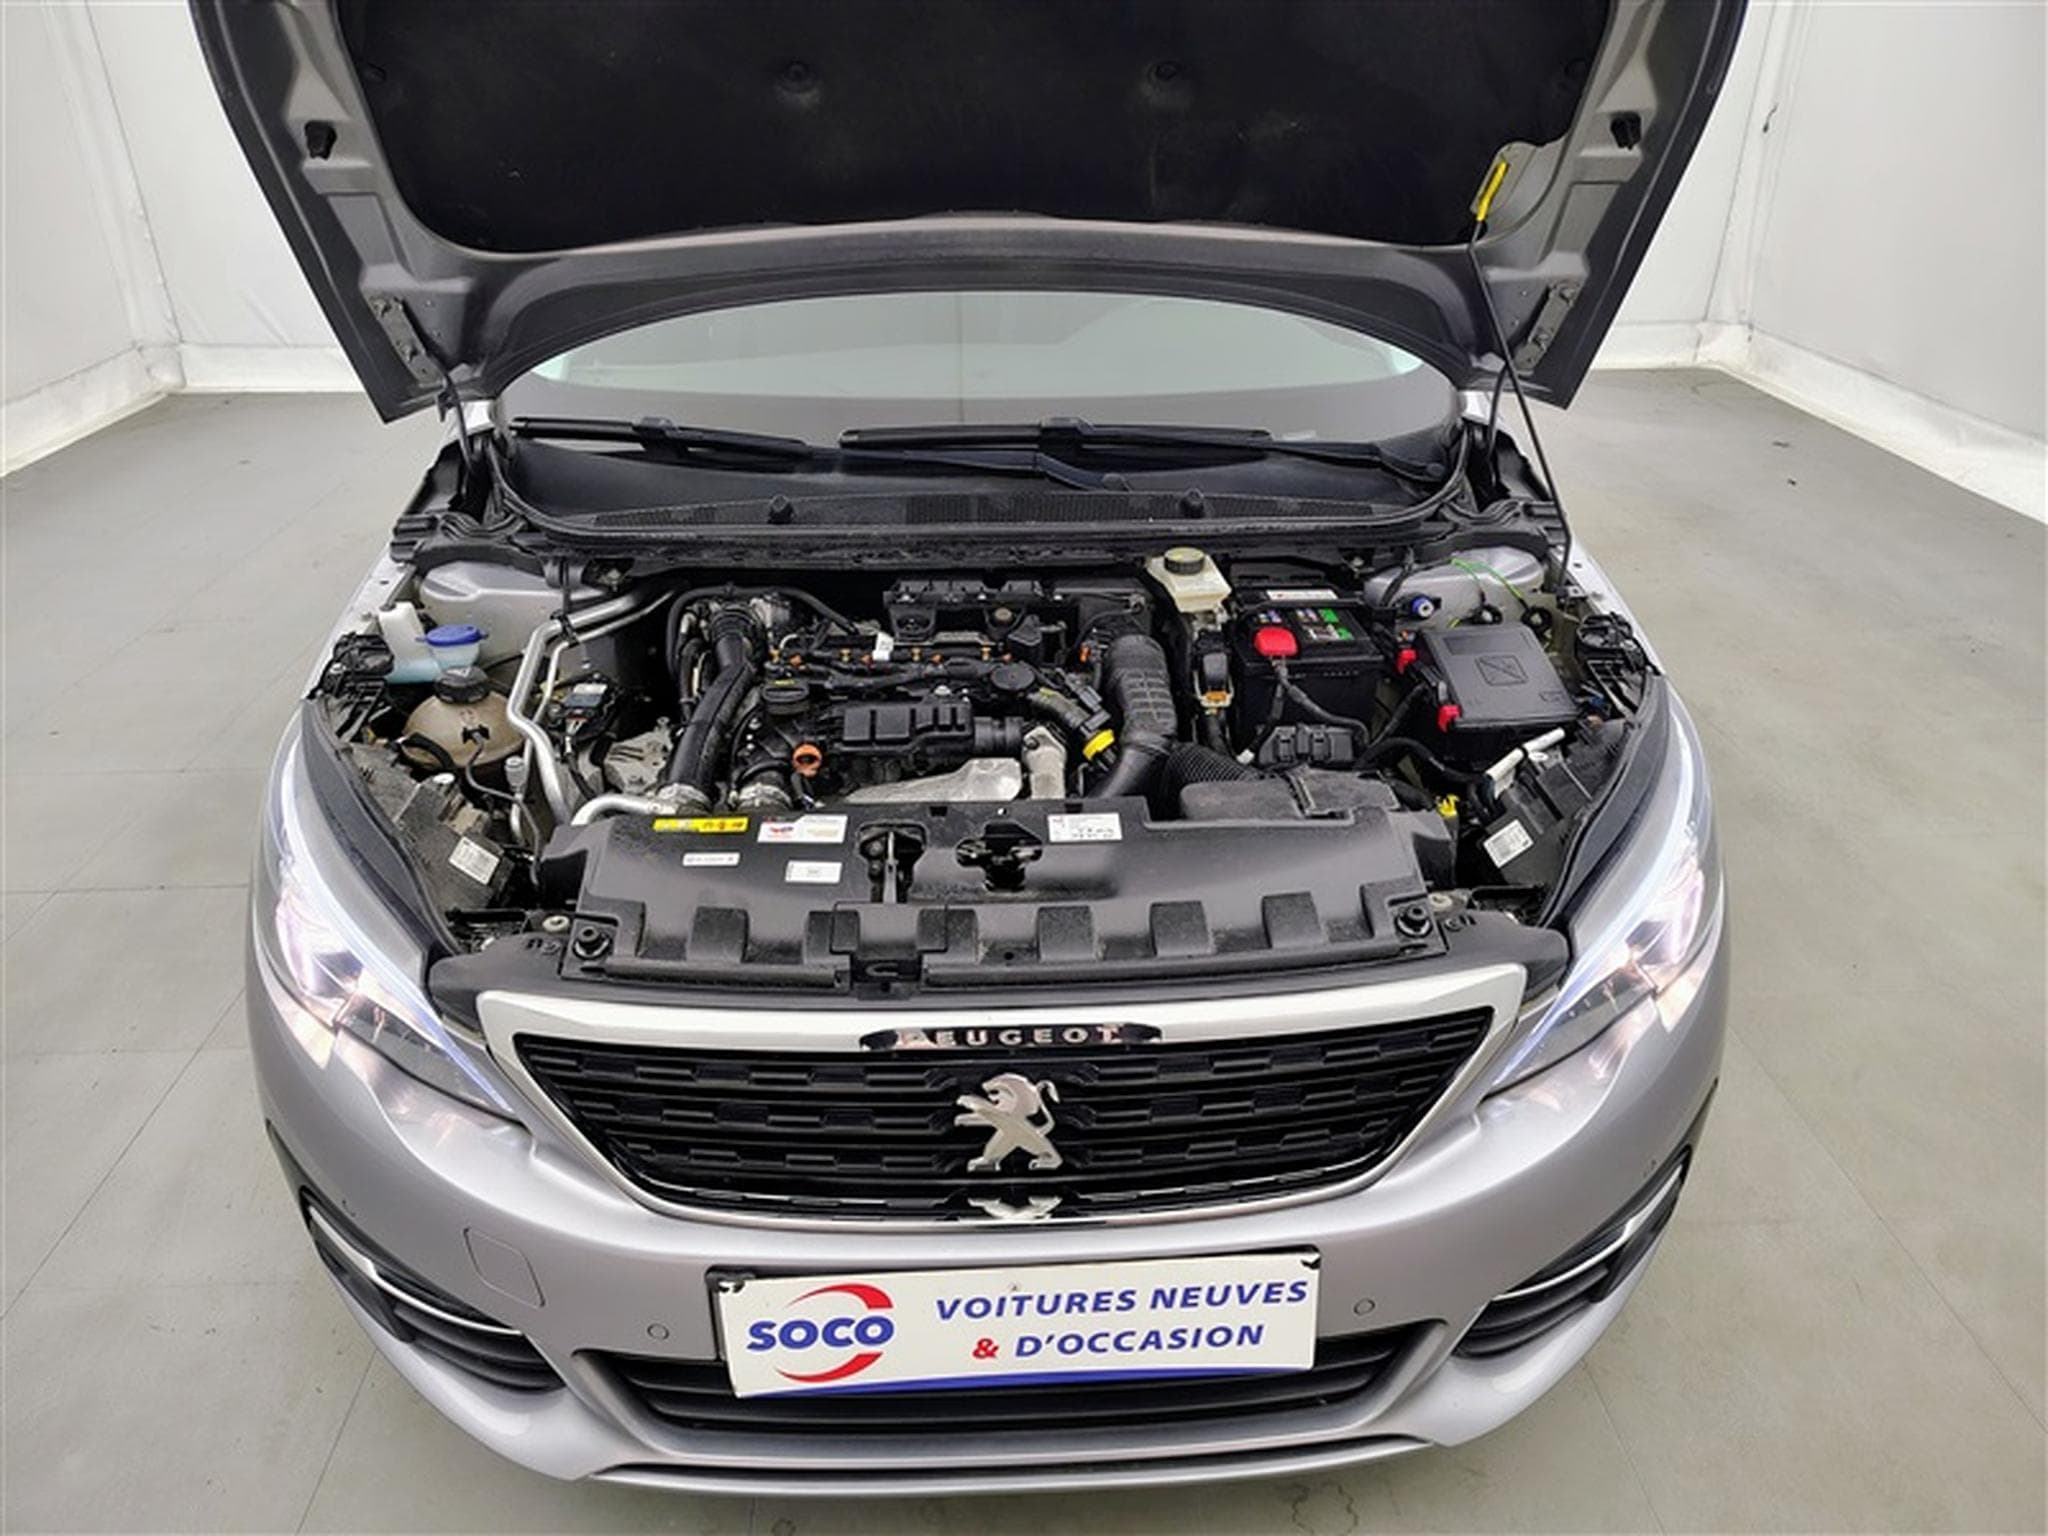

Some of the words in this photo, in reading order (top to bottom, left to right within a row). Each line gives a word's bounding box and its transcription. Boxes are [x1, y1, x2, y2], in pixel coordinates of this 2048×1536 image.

[937, 1288, 1136, 1320] VOITURES
[1150, 1281, 1308, 1311] NEUVES
[747, 1315, 894, 1351] SOCO
[972, 1338, 999, 1360] &
